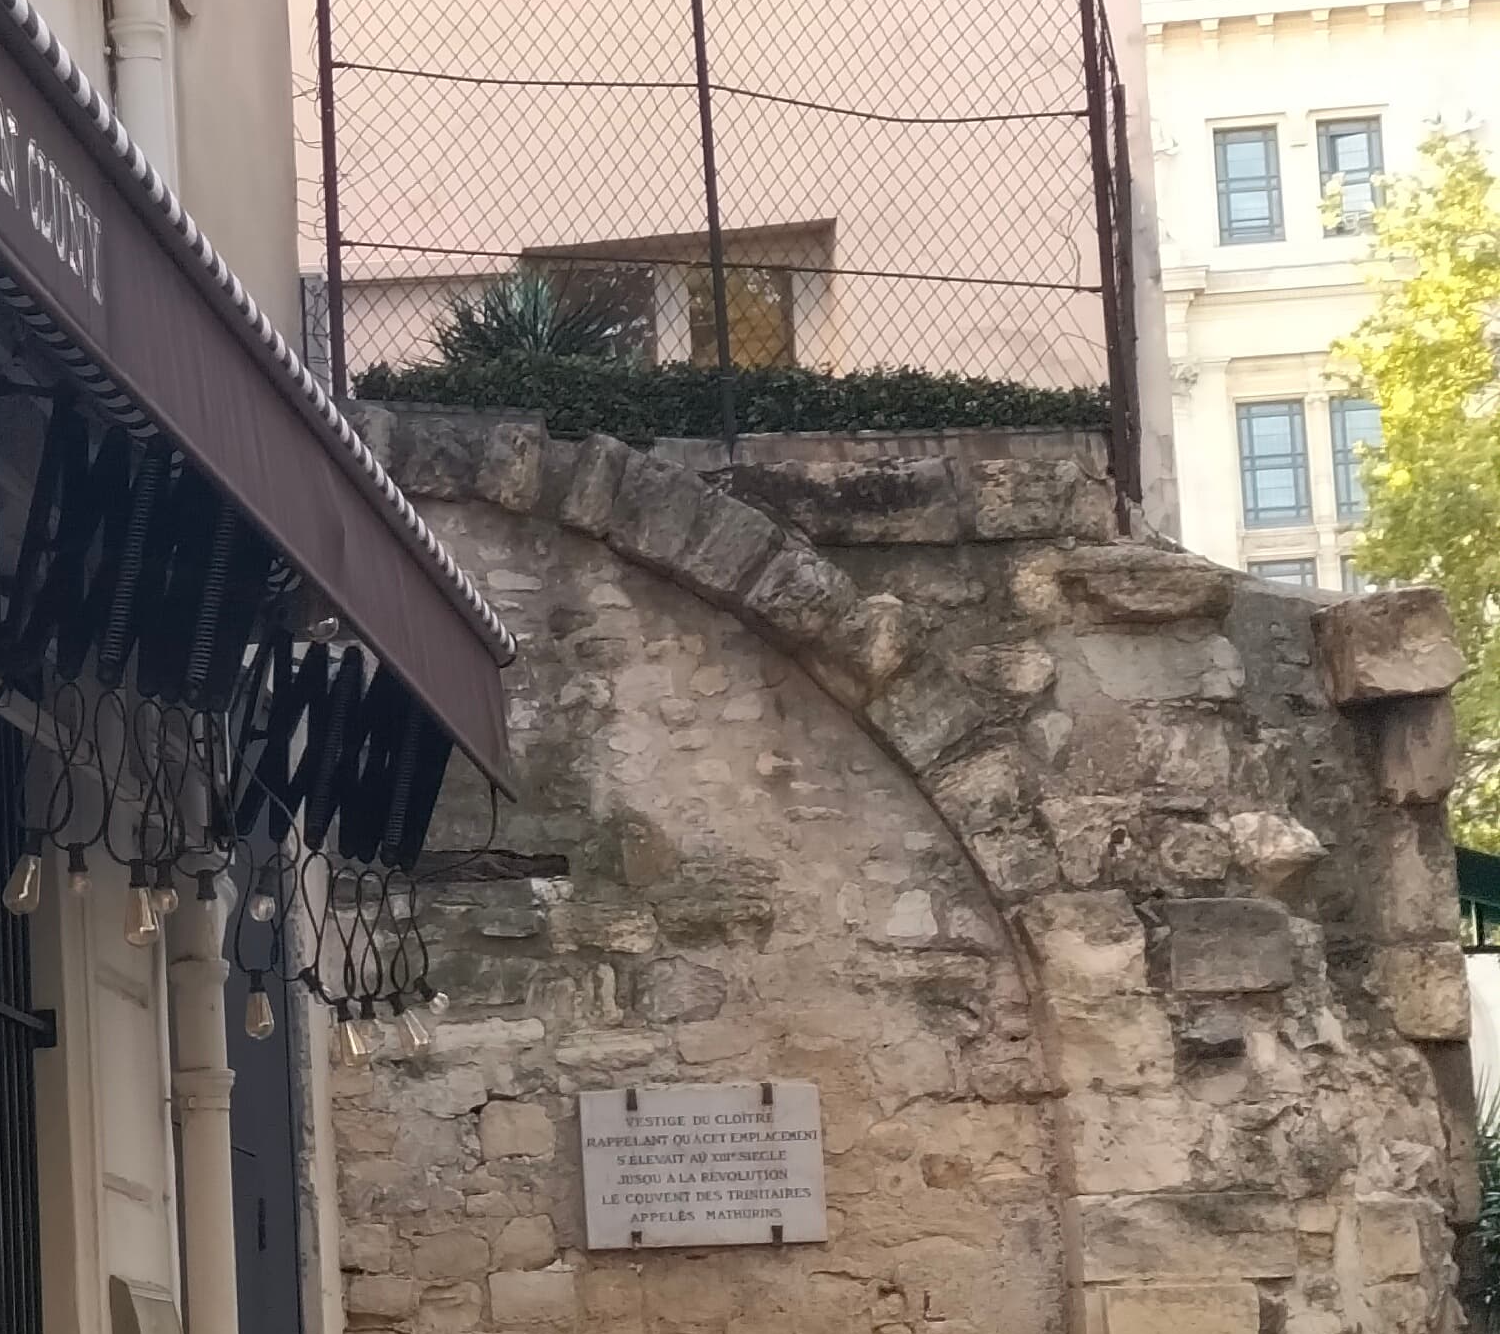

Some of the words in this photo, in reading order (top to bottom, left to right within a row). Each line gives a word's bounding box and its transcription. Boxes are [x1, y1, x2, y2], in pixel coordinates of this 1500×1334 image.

[626, 1116, 685, 1127] VESTIGE
[693, 1114, 711, 1126] DU
[587, 1134, 669, 1147] RAPPELANT
[731, 1130, 818, 1142] EMPLACEMENT
[690, 1151, 708, 1164] AU
[679, 1172, 697, 1183] LA
[602, 1194, 619, 1206] LE
[625, 1192, 691, 1205] COUVENT
[696, 1190, 723, 1202] DES
[728, 1188, 812, 1201] TRINITAIRES
[706, 1208, 783, 1221] MATHURINS
